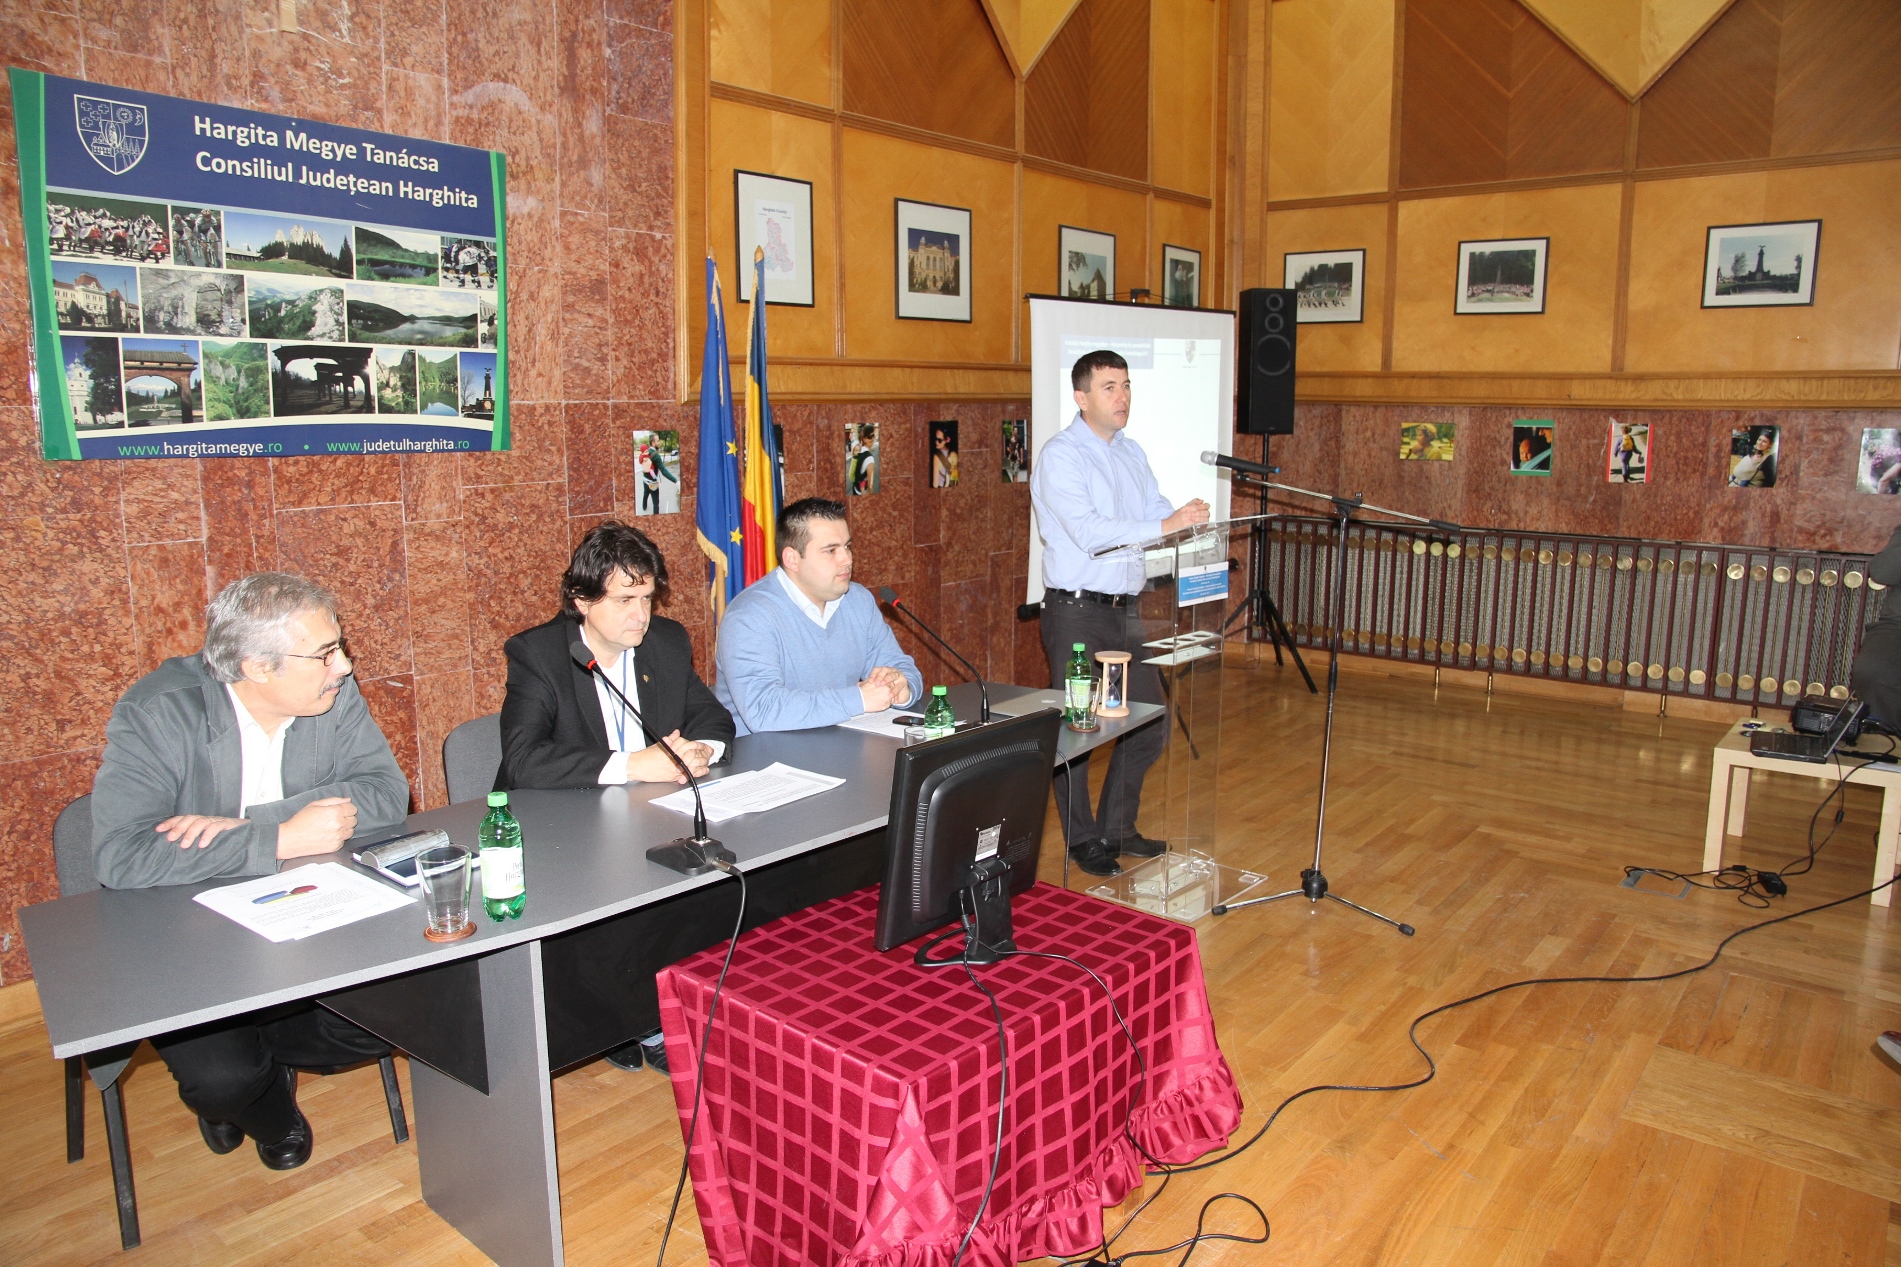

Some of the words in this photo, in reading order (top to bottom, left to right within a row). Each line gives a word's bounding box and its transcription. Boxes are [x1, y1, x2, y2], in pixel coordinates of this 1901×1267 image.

[194, 115, 279, 147] Hargita
[285, 129, 357, 162] Megye
[362, 142, 439, 172] Tanácsa
[195, 151, 293, 183] Consiliul
[298, 165, 393, 196] Județean
[399, 180, 478, 208] Harghita
[117, 441, 283, 458] www.hargitamegye.ro
[326, 438, 470, 454] www.judetulharghita.ro
